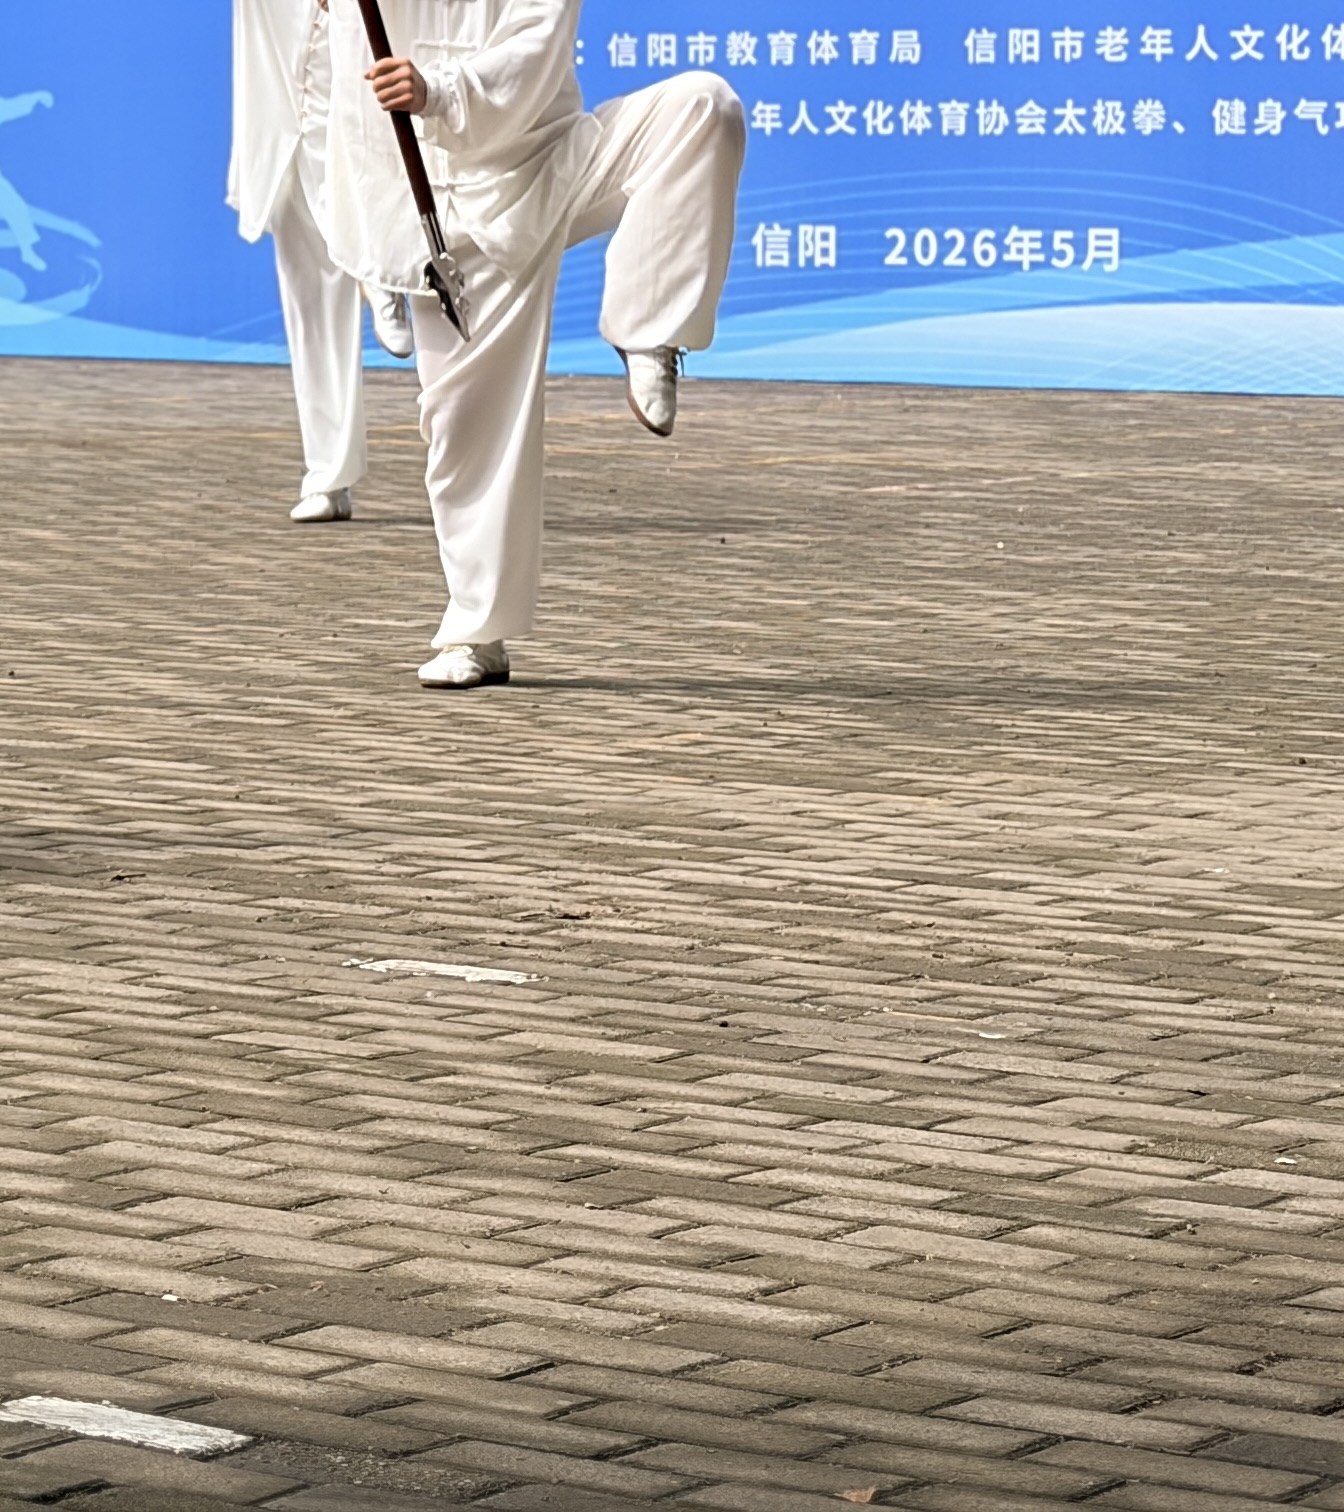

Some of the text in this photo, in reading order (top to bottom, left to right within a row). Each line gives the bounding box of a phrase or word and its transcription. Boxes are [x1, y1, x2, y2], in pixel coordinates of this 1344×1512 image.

[750, 97, 1344, 137] 年人文化体育协会太极拳、健身气
[751, 222, 1121, 272] 信阳 2026年5月
